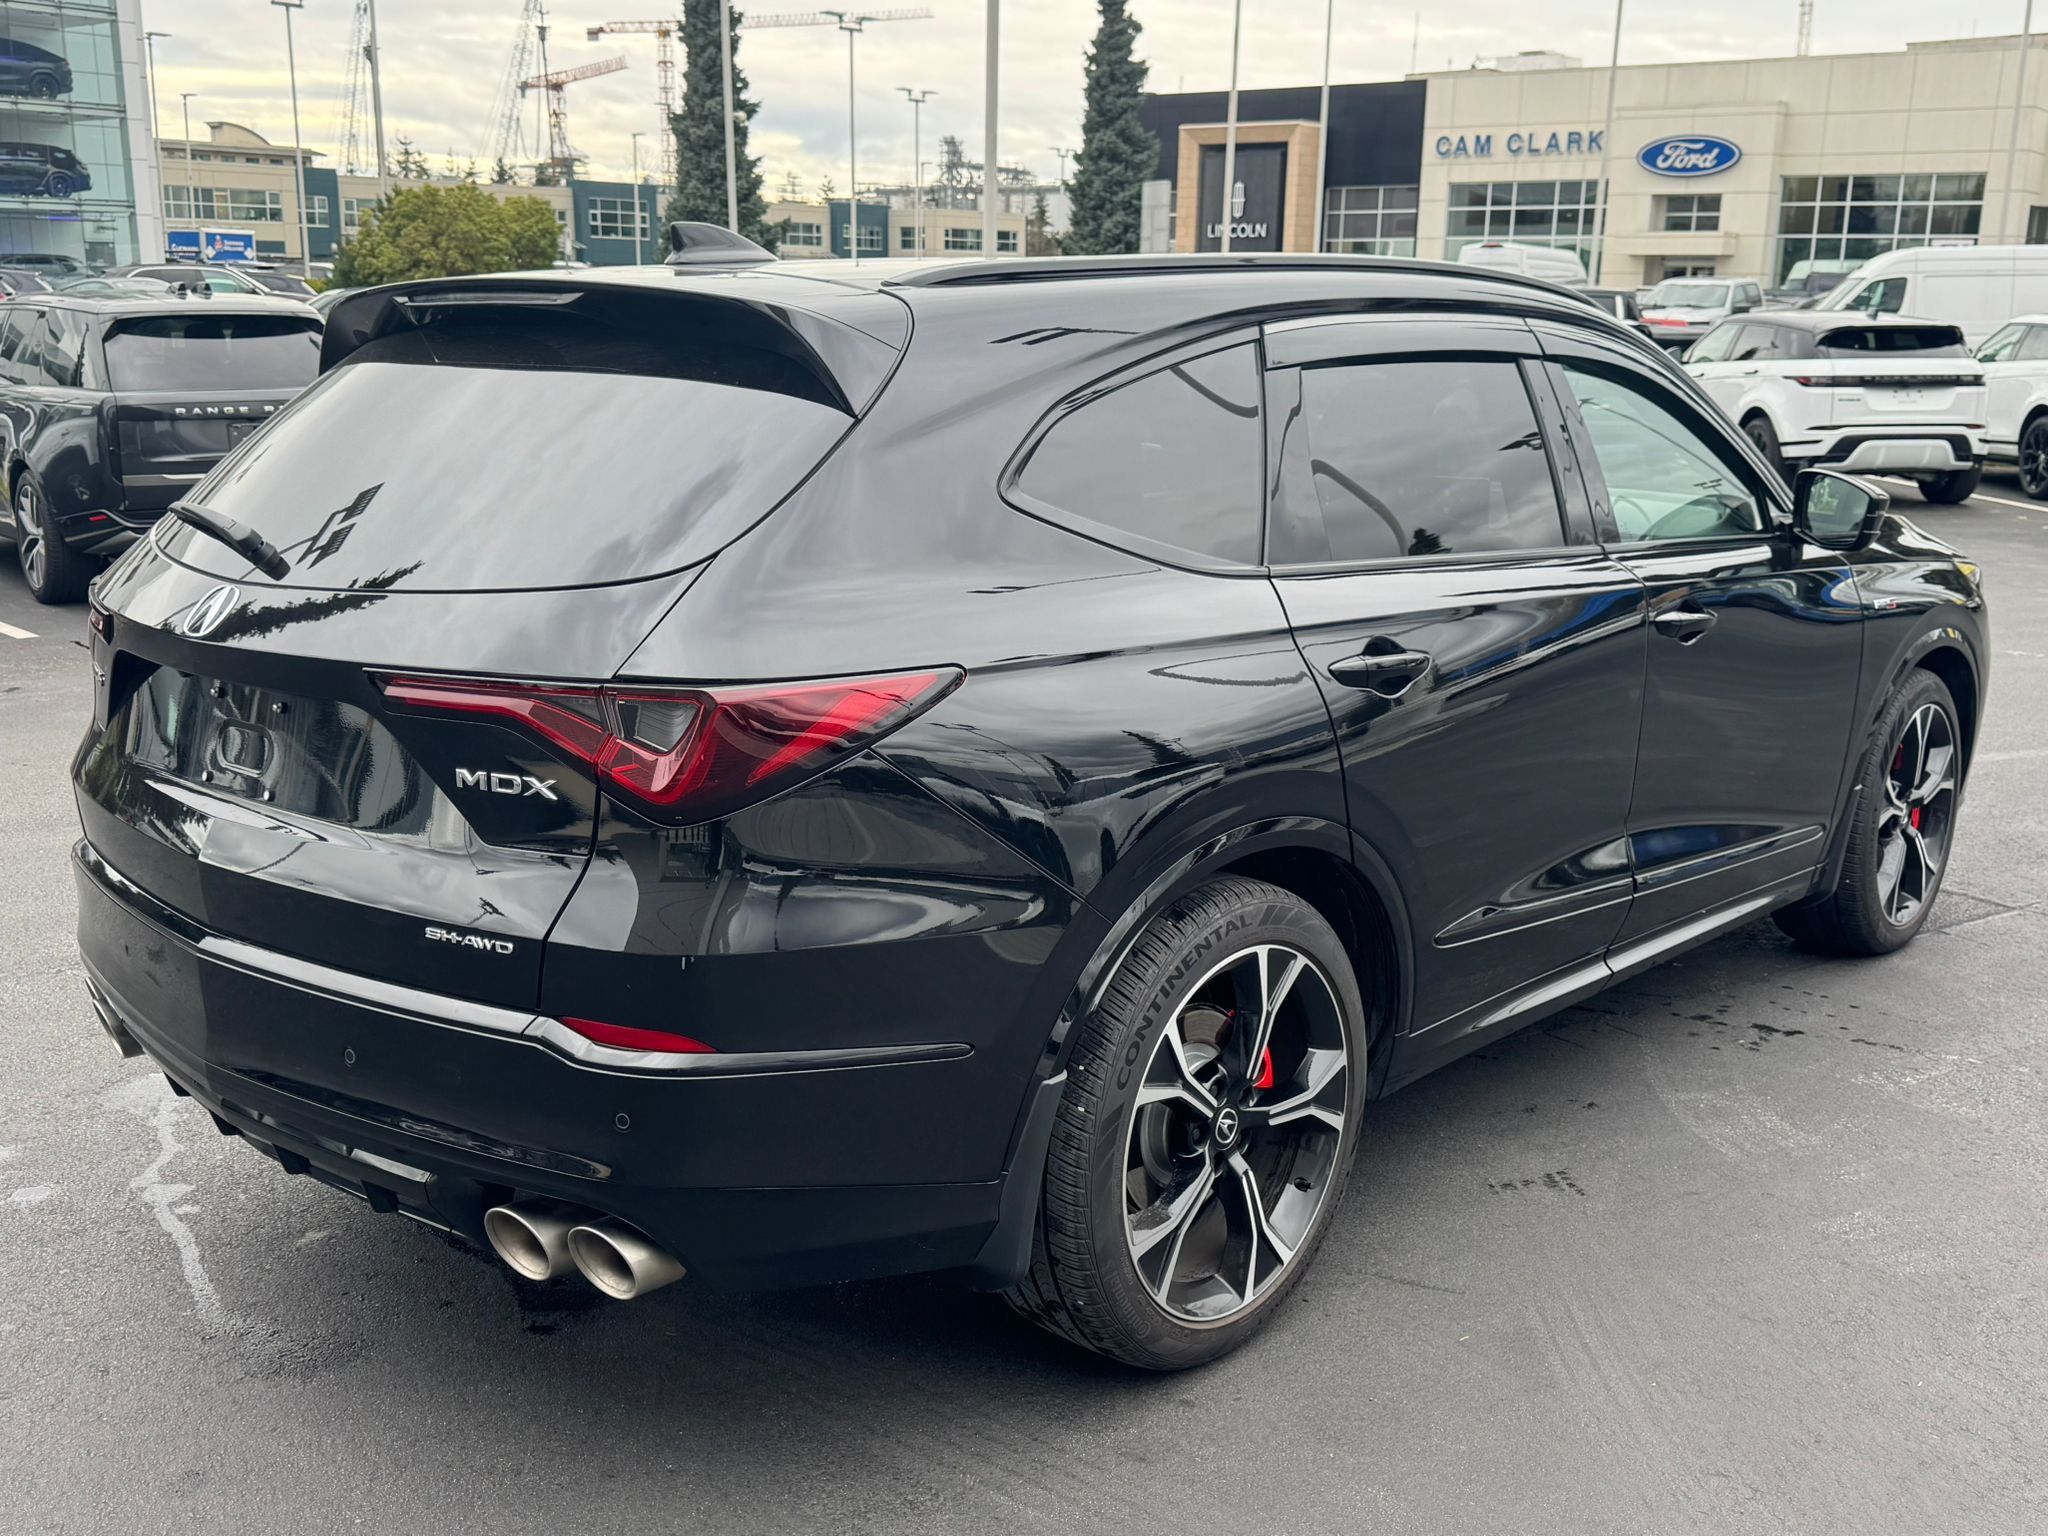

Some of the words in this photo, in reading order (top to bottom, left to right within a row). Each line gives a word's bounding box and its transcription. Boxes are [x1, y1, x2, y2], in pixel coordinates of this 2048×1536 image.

[1436, 134, 1492, 158] CAM
[1506, 130, 1604, 155] CLARK
[1655, 141, 1720, 170] Ford
[174, 406, 249, 416] RANGE
[455, 768, 559, 801] MDX
[424, 926, 514, 955] SH-AWD
[1117, 914, 1254, 1091] CONTINENTAL
